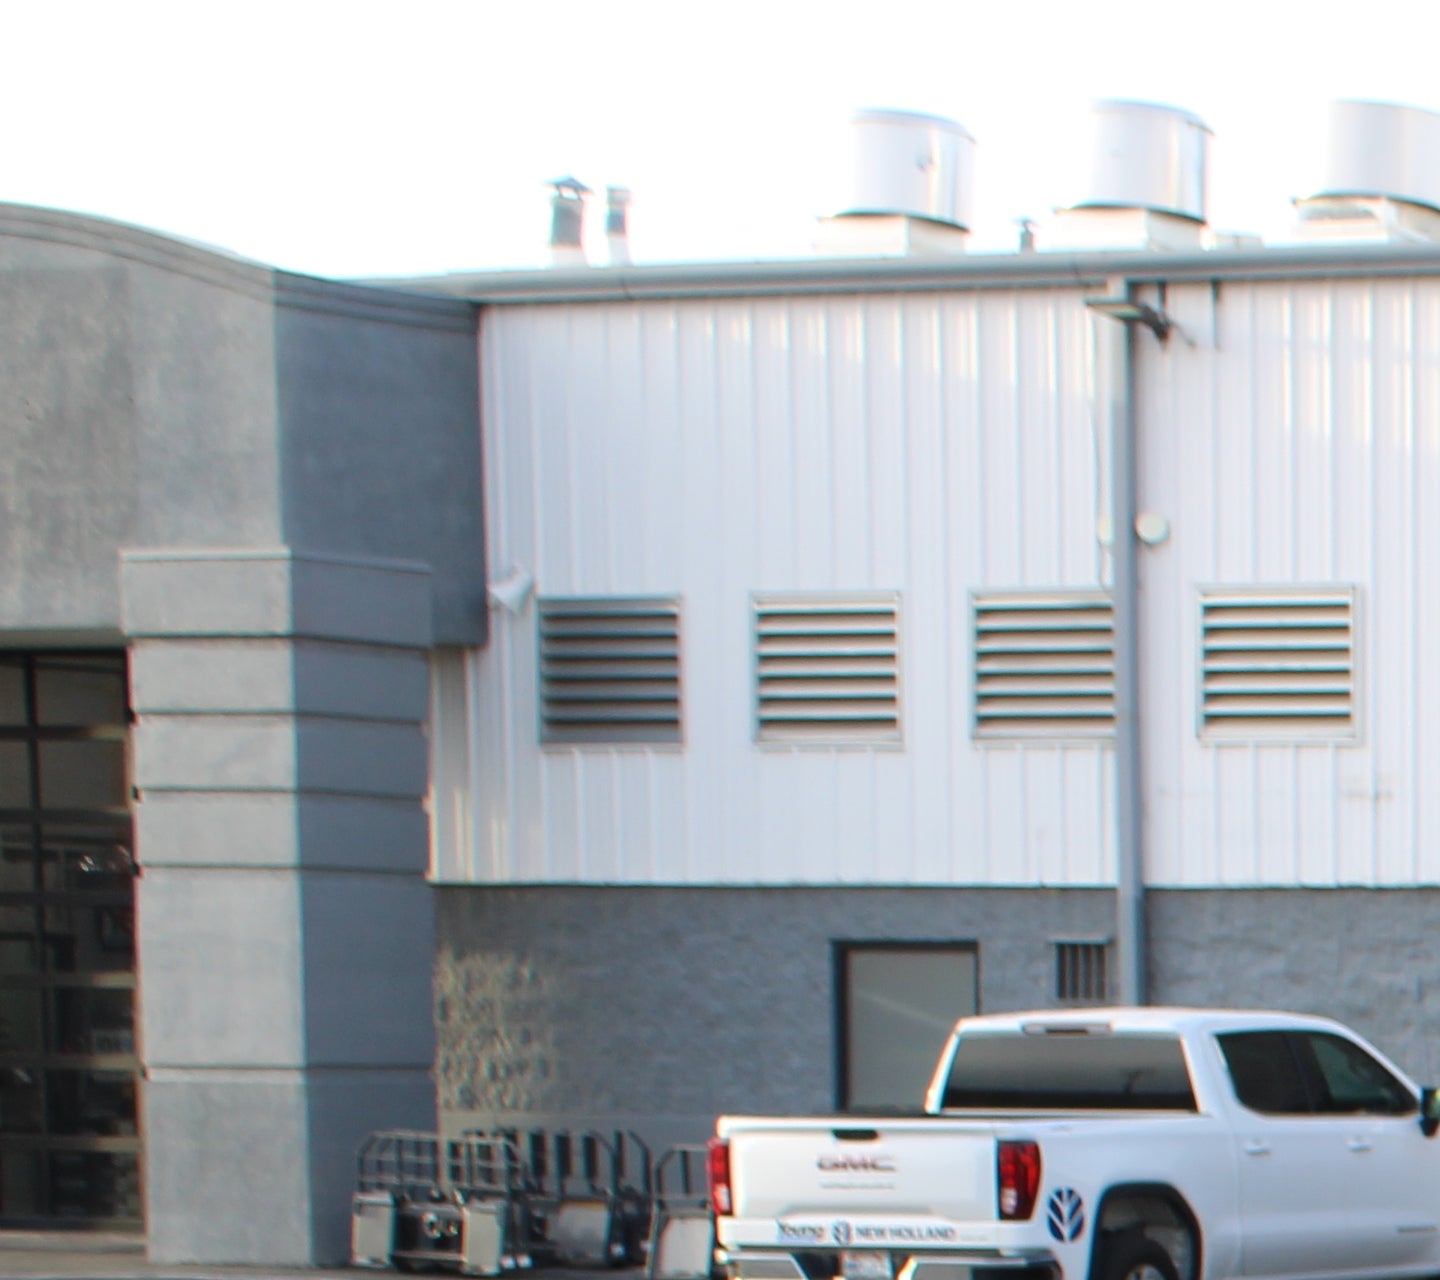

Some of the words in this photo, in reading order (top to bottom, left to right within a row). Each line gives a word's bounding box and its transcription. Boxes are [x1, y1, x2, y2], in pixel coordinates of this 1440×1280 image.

[816, 1156, 897, 1172] GMC
[854, 1223, 887, 1241] NEW
[889, 1223, 957, 1241] HOLLAND
